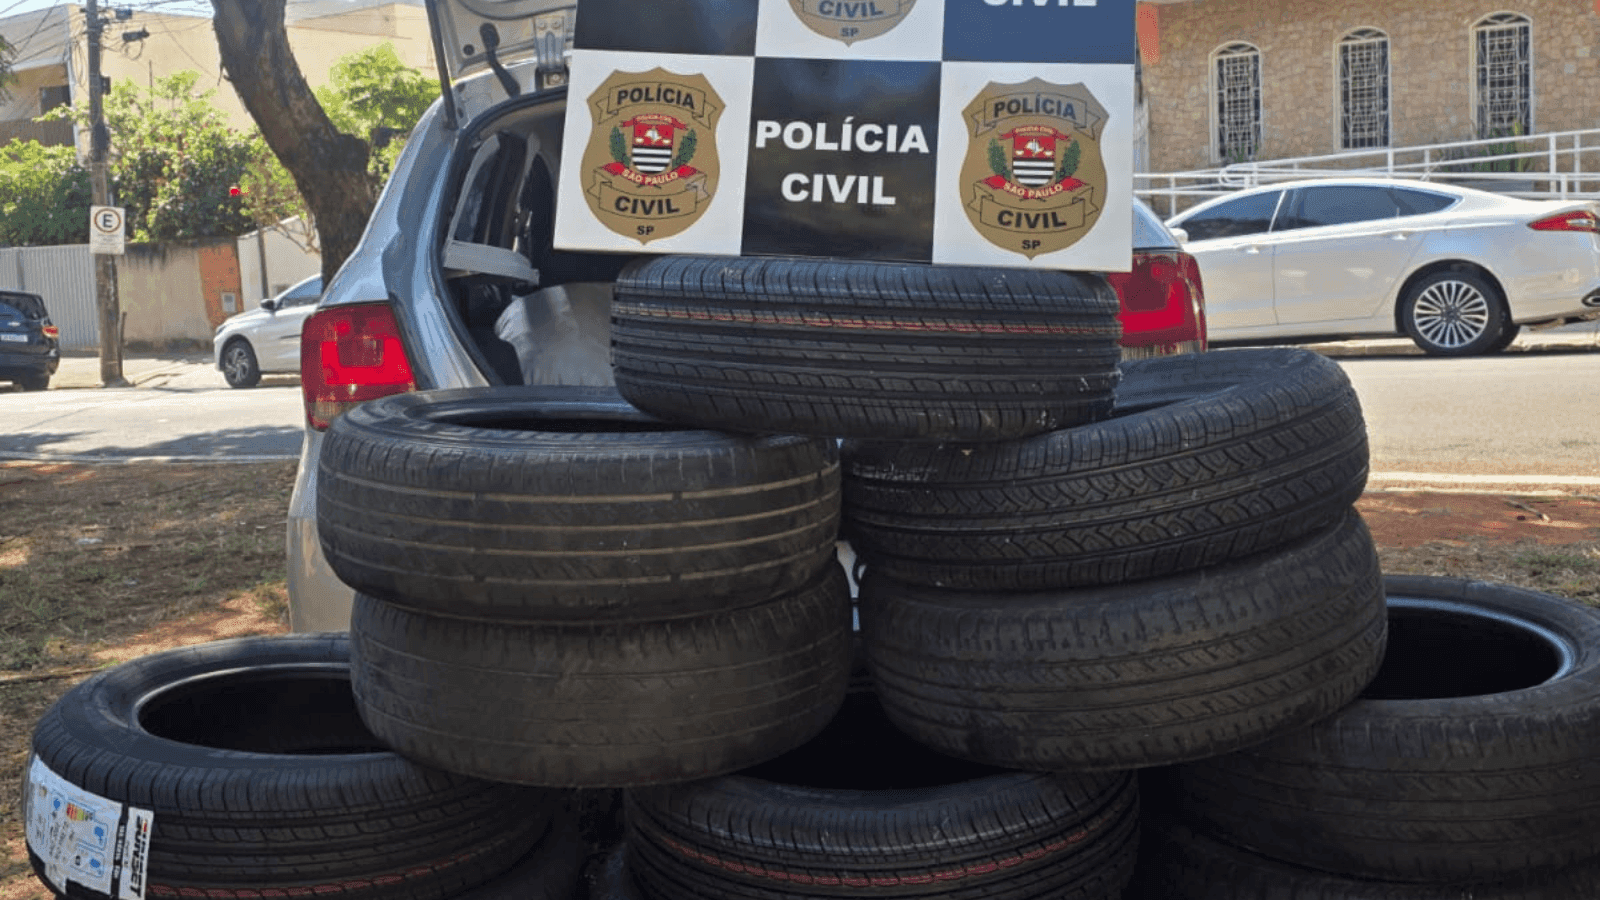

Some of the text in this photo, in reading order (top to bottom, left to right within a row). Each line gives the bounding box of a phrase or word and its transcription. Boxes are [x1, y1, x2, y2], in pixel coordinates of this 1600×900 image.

[818, 0, 884, 18] CIVIL
[841, 27, 859, 37] SP
[617, 83, 695, 110] POLÍCIA
[994, 93, 1076, 120] POLÍCIA
[756, 116, 930, 153] POLÍCIA
[644, 171, 679, 185] PAULO
[781, 172, 896, 205] CIVIL
[1028, 183, 1064, 198] PAULO
[614, 196, 680, 215] CIVIL
[103, 214, 113, 228] E
[997, 210, 1067, 228] CIVIL
[636, 225, 655, 236] SP
[1021, 239, 1041, 250] SP
